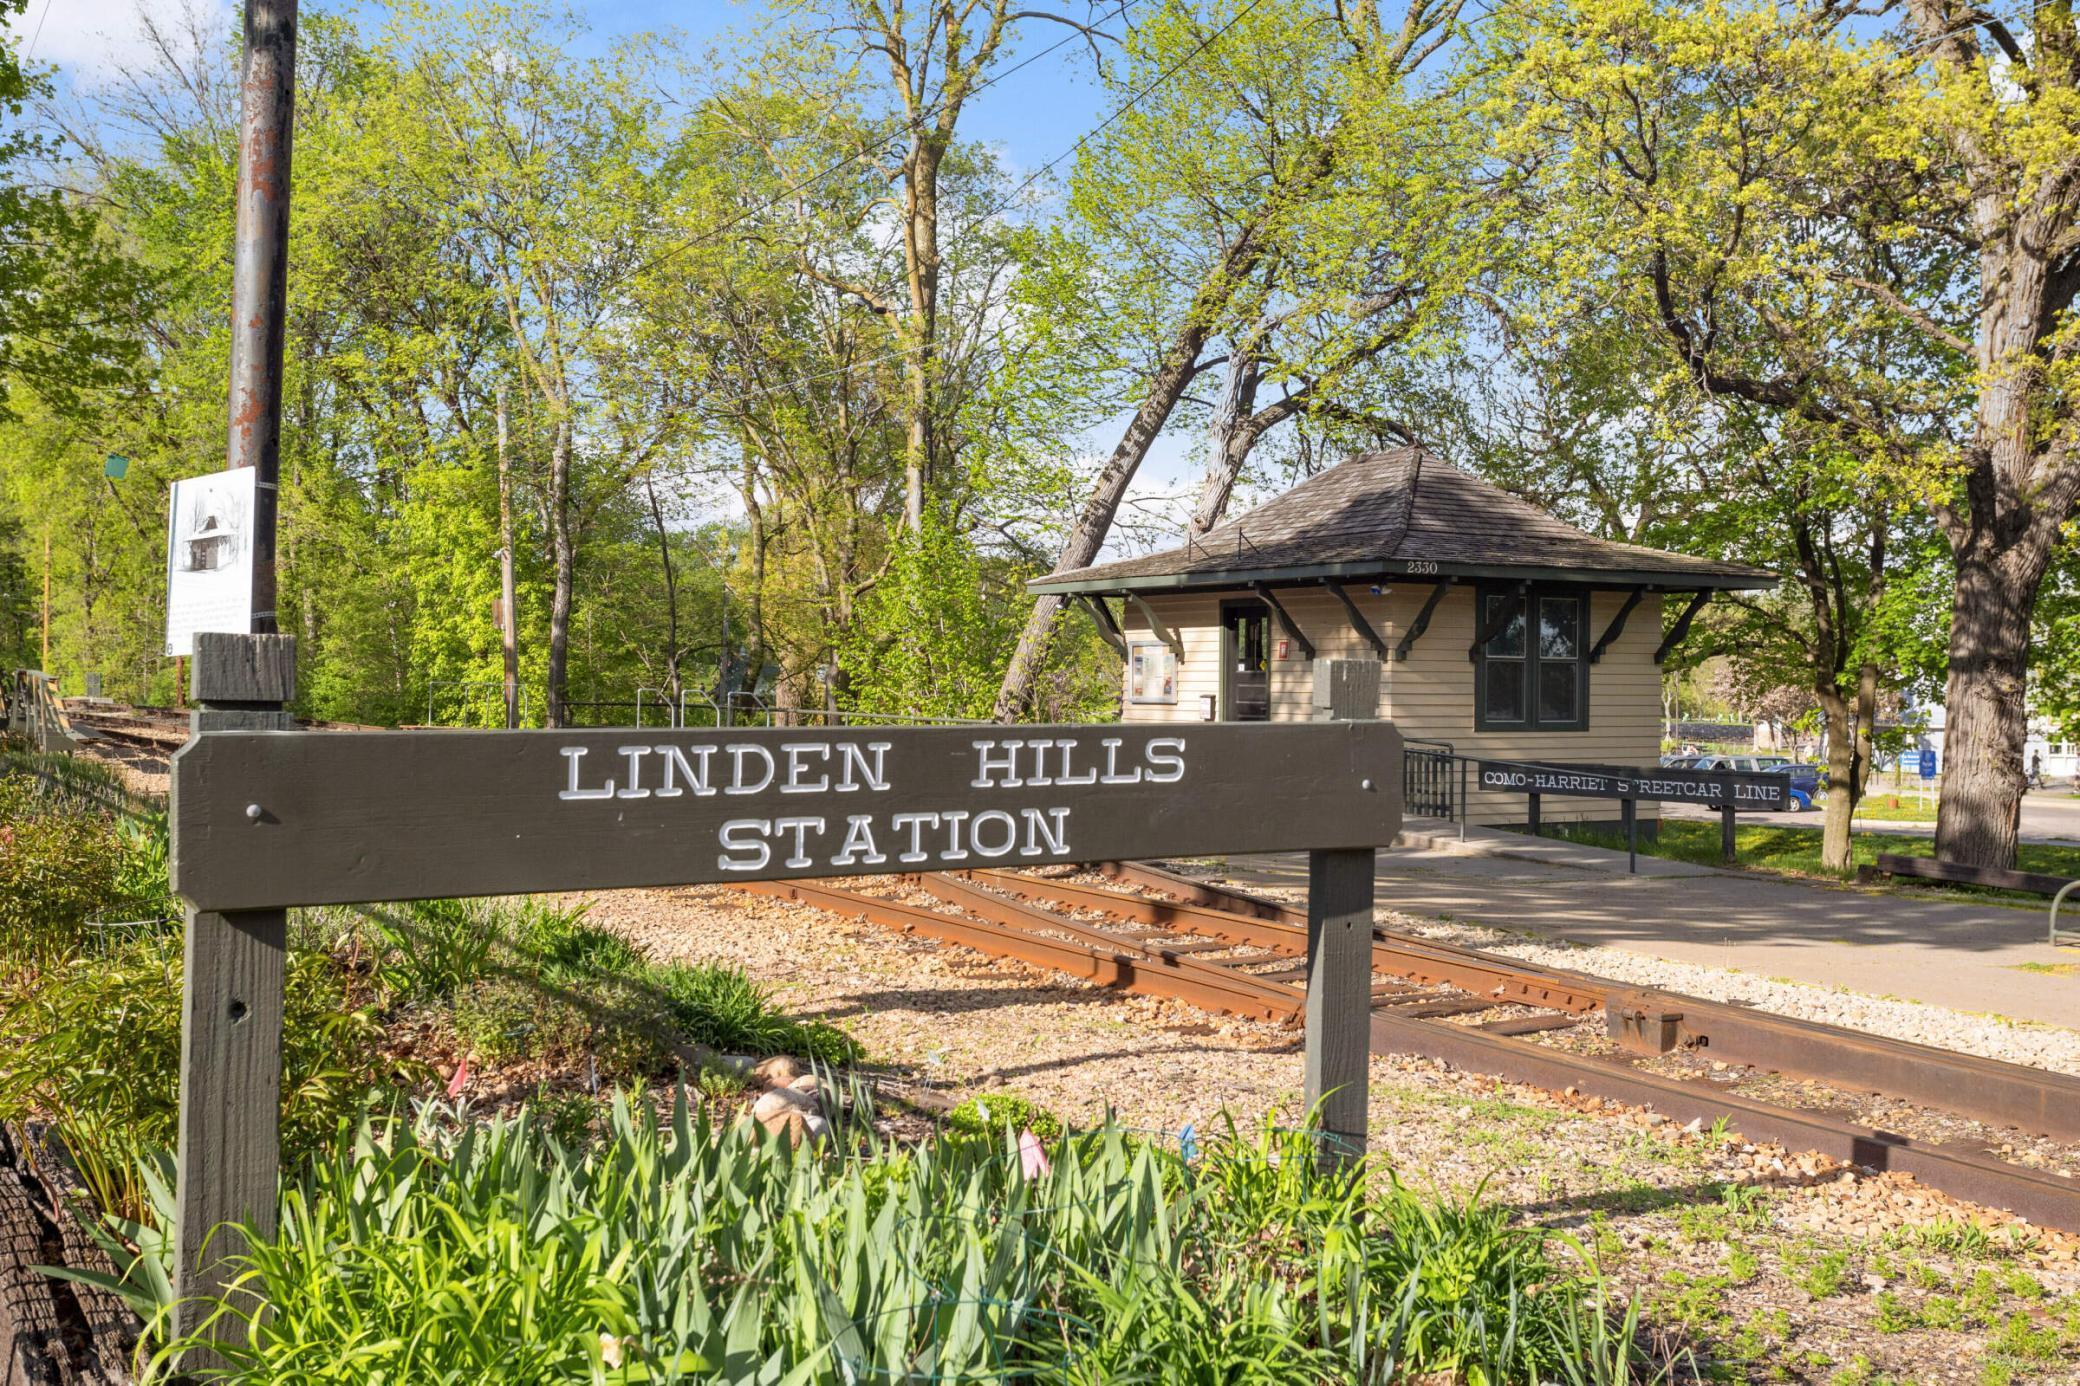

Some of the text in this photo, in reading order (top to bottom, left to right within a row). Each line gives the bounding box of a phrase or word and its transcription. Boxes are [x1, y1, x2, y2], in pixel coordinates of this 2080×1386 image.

[1407, 560, 1438, 575] 2330
[559, 738, 1186, 800] LINDEN HILLS
[1484, 771, 1781, 801] COMO-HARRIET SREETCAR LINE
[718, 807, 1071, 871] STATION
